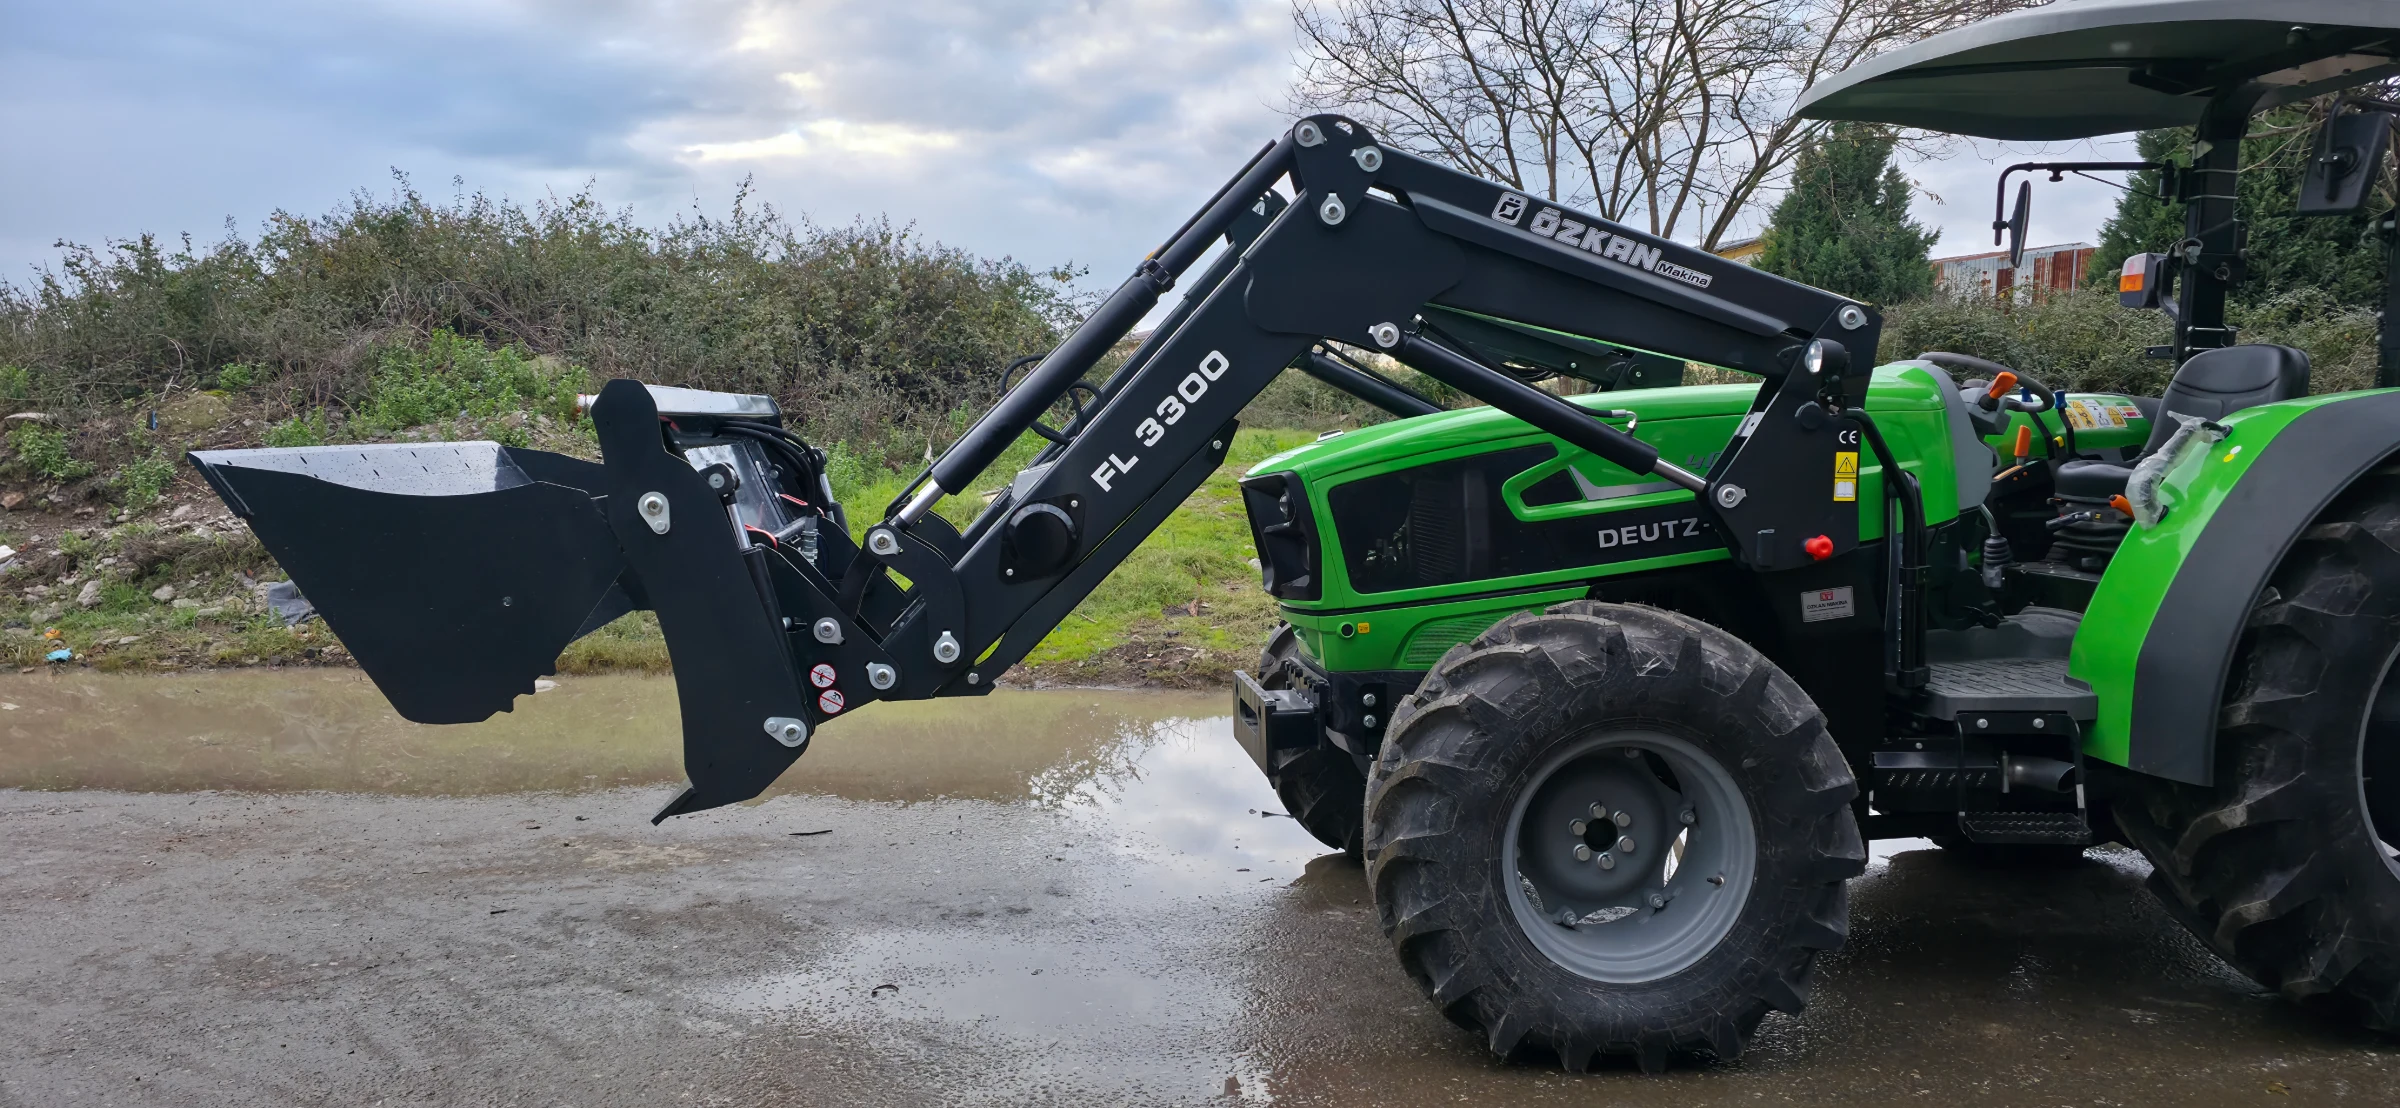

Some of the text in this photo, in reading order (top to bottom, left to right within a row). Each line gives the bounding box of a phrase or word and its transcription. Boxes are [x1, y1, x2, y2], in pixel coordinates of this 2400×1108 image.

[1530, 206, 1662, 271] ÖZKAN
[1657, 262, 1709, 287] Makina
[1090, 350, 1230, 493] FL 3300
[1838, 430, 1857, 444] CE
